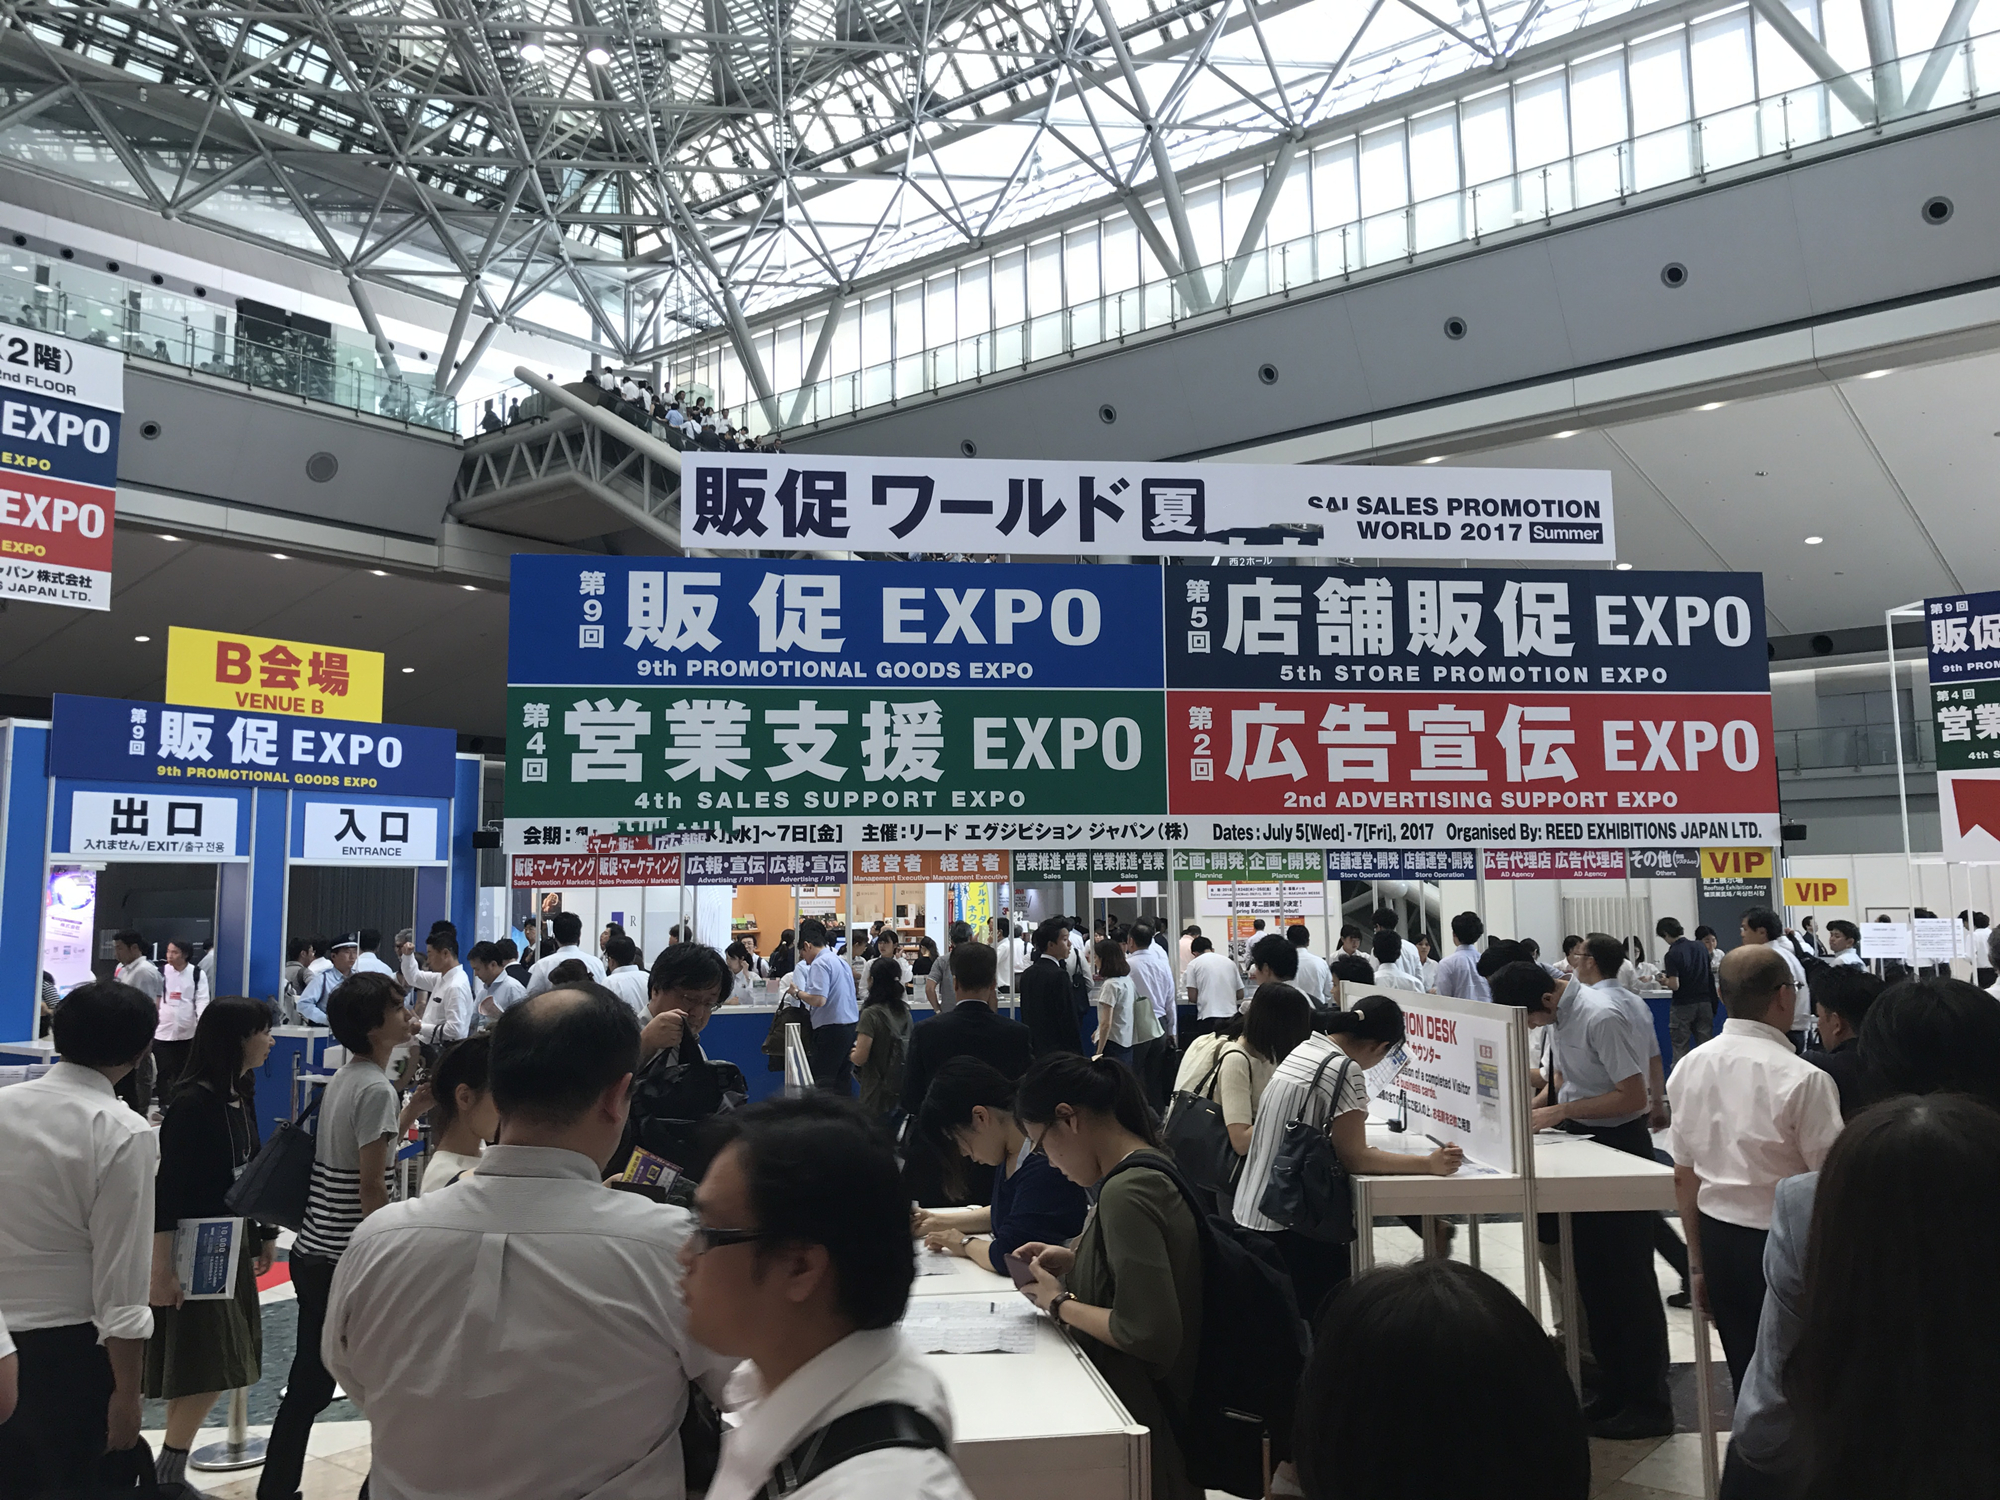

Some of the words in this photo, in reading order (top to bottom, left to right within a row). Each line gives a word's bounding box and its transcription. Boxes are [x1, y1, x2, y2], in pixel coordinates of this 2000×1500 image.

[0, 370, 20, 383] nd
[25, 375, 77, 396] FLOOR
[2, 401, 110, 454] EXPO
[2, 452, 51, 470] EXPO
[0, 489, 105, 539] EXPO
[1149, 487, 1197, 535] 夏
[1357, 497, 1439, 516] SALES
[1447, 499, 1600, 518] PROMOTION
[1357, 520, 1451, 541] WORLD
[1461, 524, 1522, 542] 2017
[1533, 525, 1600, 541] Summer
[2, 540, 46, 557] EXPO
[8, 583, 57, 597] JAPAN
[62, 590, 91, 602] LTD.
[578, 569, 606, 649] 第9回
[624, 571, 845, 652] 販促
[883, 587, 1101, 647] EXPO
[1186, 579, 1211, 654] 第5回
[1222, 577, 1573, 658] 店舗販促
[1596, 596, 1752, 648] EXPO
[1930, 601, 1968, 615] 第9回
[216, 640, 350, 697] B会場
[637, 659, 677, 677] 9th
[687, 660, 866, 678] PROMOTIONAL
[876, 662, 961, 679] GOODS
[969, 662, 1033, 679] EXPO
[1280, 665, 1322, 682] 5th
[1334, 665, 1420, 683] STORE
[1434, 667, 1589, 683] PROMOTION
[1601, 667, 1667, 683] EXPO
[1942, 664, 1962, 673] 9th
[235, 692, 305, 713] VENUE
[311, 699, 324, 714] B
[1936, 689, 1975, 702] 第4回
[129, 708, 147, 756] 第9回
[158, 710, 279, 766] 販促
[292, 729, 402, 768] EXPO
[564, 698, 944, 783] 営業支援
[974, 716, 1142, 772] EXPO
[523, 702, 549, 782] 第4回
[1189, 706, 1214, 781] 第2回
[1225, 702, 1579, 784] 広告宣伝
[1603, 720, 1760, 771] EXPO
[1968, 751, 1988, 760] 4th
[157, 765, 181, 777] 9th
[187, 767, 289, 783] PROMOTIONAL
[295, 774, 339, 786] GOODS
[344, 776, 377, 788] EXPO
[635, 791, 681, 809] 4th
[698, 791, 789, 809] SALES
[804, 791, 934, 808] SUPPORT
[951, 790, 1026, 808] EXPO
[1284, 792, 1326, 810] 2nd
[1335, 792, 1493, 809] ADVERTISING
[1501, 792, 1612, 809] SUPPORT
[1618, 792, 1678, 809] EXPO
[110, 798, 203, 837] 出口
[334, 808, 408, 843] 入口
[965, 823, 1082, 840] エグジビション
[1263, 823, 1292, 842] July
[1296, 823, 1345, 841] 5[Wed]
[1401, 823, 1433, 840] 2017
[1446, 822, 1516, 843] Organised
[1520, 823, 1542, 842] By:
[1546, 823, 1583, 840] REED
[1588, 822, 1677, 840] EXHIBITIONS
[1681, 822, 1726, 839] JAPAN
[1733, 822, 1762, 839] LTD.
[342, 846, 402, 857] ENTRANCE
[1173, 852, 1245, 870] 企画・開発
[1249, 852, 1321, 870] 企画・開発
[1329, 852, 1400, 870] 店舗運営・開発
[1404, 851, 1474, 870] 店舗運営・開発
[1484, 851, 1552, 870] 広告代理店
[1555, 851, 1624, 869] 広告代理店
[687, 855, 766, 875] 広報・宣伝
[769, 854, 846, 874] 広報・宣伝
[861, 854, 922, 873] 経営者
[940, 853, 1000, 872] 経営者
[1015, 852, 1087, 872] 営業推進・営業
[1093, 852, 1165, 871] 営業推進・営業
[1709, 851, 1764, 873] VIP
[566, 879, 596, 887] Marketing
[616, 878, 647, 886] Promotion
[651, 877, 680, 886] Marketing
[698, 876, 736, 885] Advertising
[780, 875, 817, 884] Advertising
[933, 874, 974, 882] Management
[976, 873, 1008, 881] Executive
[1511, 871, 1535, 879] Agency
[1584, 871, 1607, 879] Agency
[1796, 883, 1837, 901] VIP
[1427, 1016, 1458, 1045] DESK
